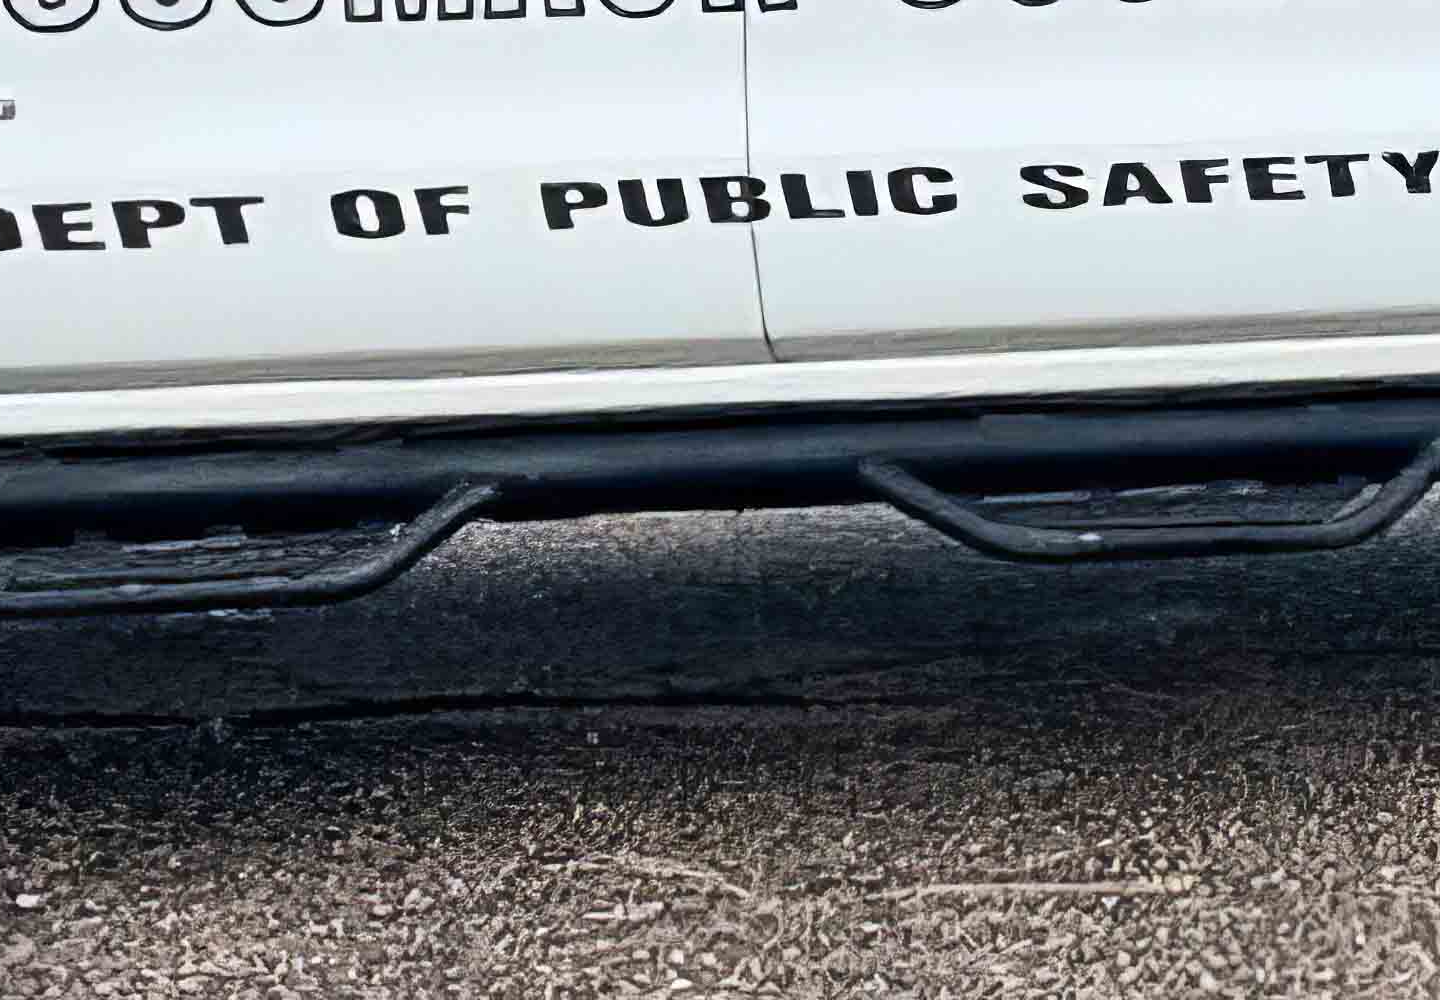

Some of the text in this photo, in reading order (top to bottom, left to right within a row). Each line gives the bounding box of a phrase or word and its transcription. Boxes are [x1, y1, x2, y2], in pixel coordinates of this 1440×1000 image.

[329, 185, 471, 240] OF
[539, 165, 959, 230] PUBLIC
[1019, 149, 1440, 210] SAFETY
